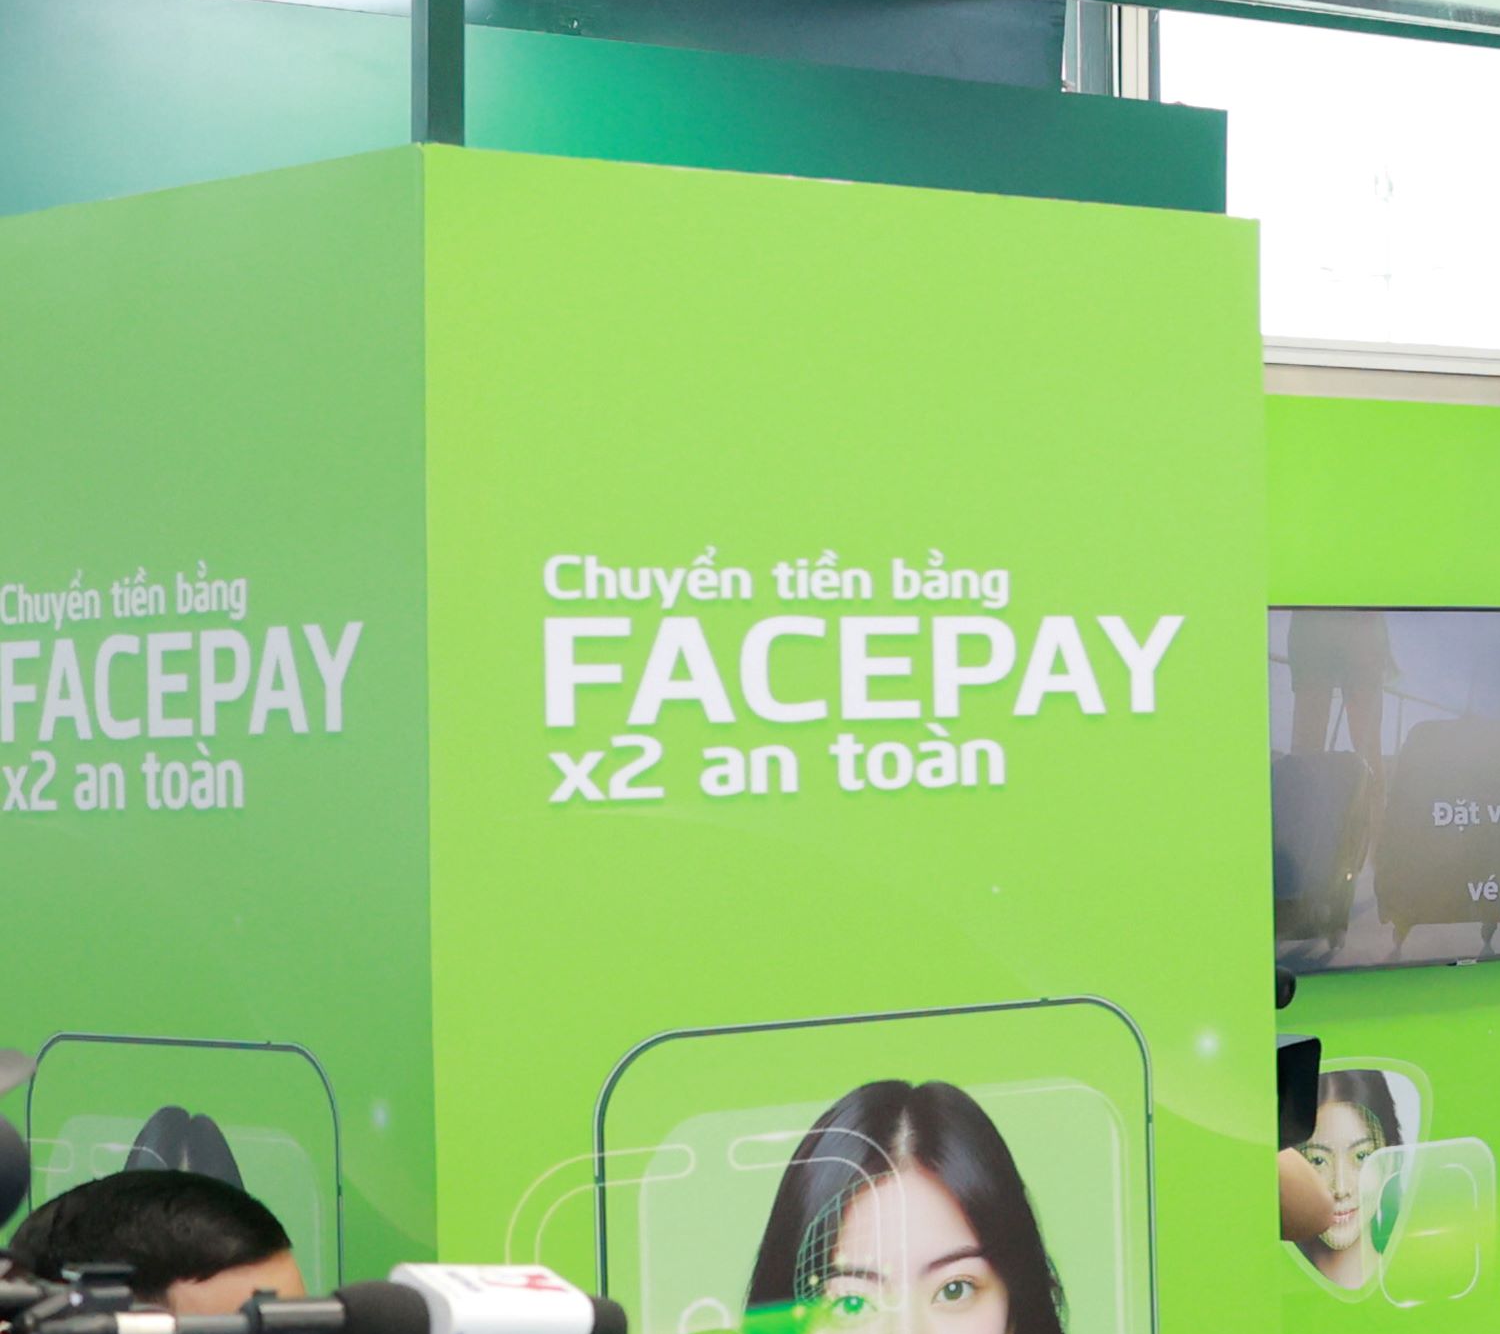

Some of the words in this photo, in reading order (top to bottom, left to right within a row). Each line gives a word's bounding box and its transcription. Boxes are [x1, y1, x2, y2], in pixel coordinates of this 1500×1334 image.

[0, 569, 102, 631] Chuyển
[110, 566, 166, 618] tiền
[176, 559, 248, 621] bằng
[543, 545, 754, 611] Chuyển
[772, 549, 875, 602] tiền
[891, 547, 1010, 610] bằng
[0, 621, 365, 744] FACEPAY
[543, 614, 1187, 728] FACEPAY
[2, 750, 58, 812] x2
[73, 762, 126, 812] an
[140, 741, 245, 811] toàn
[547, 733, 666, 804] x2
[699, 743, 801, 799] an
[828, 722, 1007, 793] toàn
[1432, 800, 1481, 832] Đặt
[1467, 875, 1499, 902] vé
